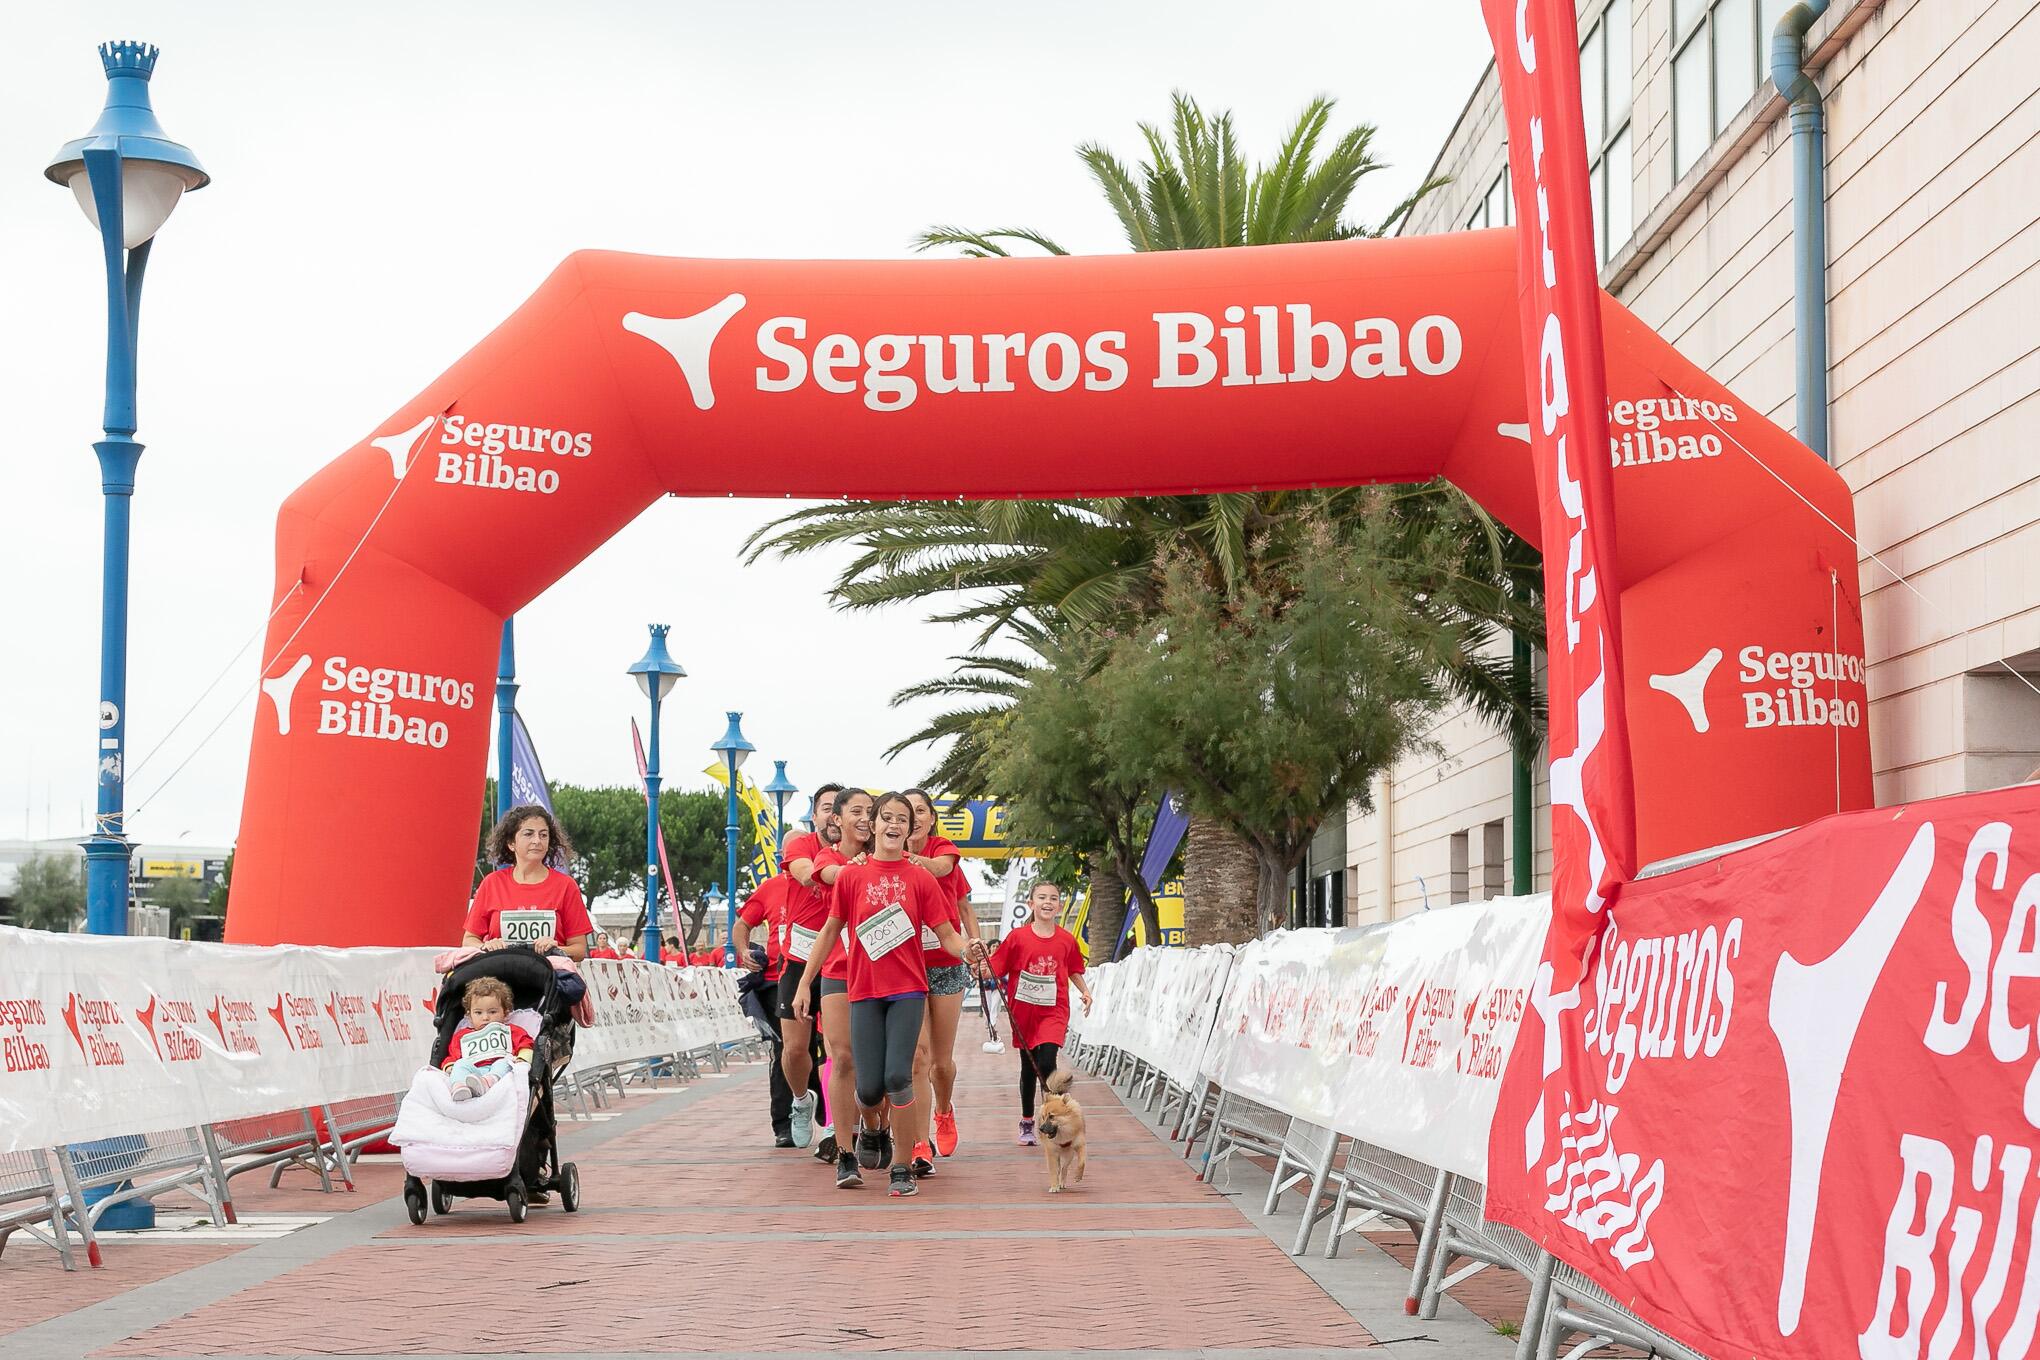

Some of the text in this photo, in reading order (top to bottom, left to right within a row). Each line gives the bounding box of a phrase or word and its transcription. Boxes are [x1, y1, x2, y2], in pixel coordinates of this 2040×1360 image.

[756, 303, 1464, 412] Seguros Bilbao
[1606, 394, 1739, 431] eguros
[440, 415, 592, 457] Seguros
[434, 452, 560, 494] Bilbao
[321, 656, 474, 709] Seguros
[317, 691, 449, 748] Bilbao
[1742, 688, 1861, 728] Bilbao
[506, 921, 552, 941] 2060
[866, 919, 899, 946] 2069
[1922, 820, 2040, 1131] Se
[0, 999, 46, 1033] eguros
[4, 1035, 50, 1072] Bilbao
[467, 1032, 508, 1057] 2060
